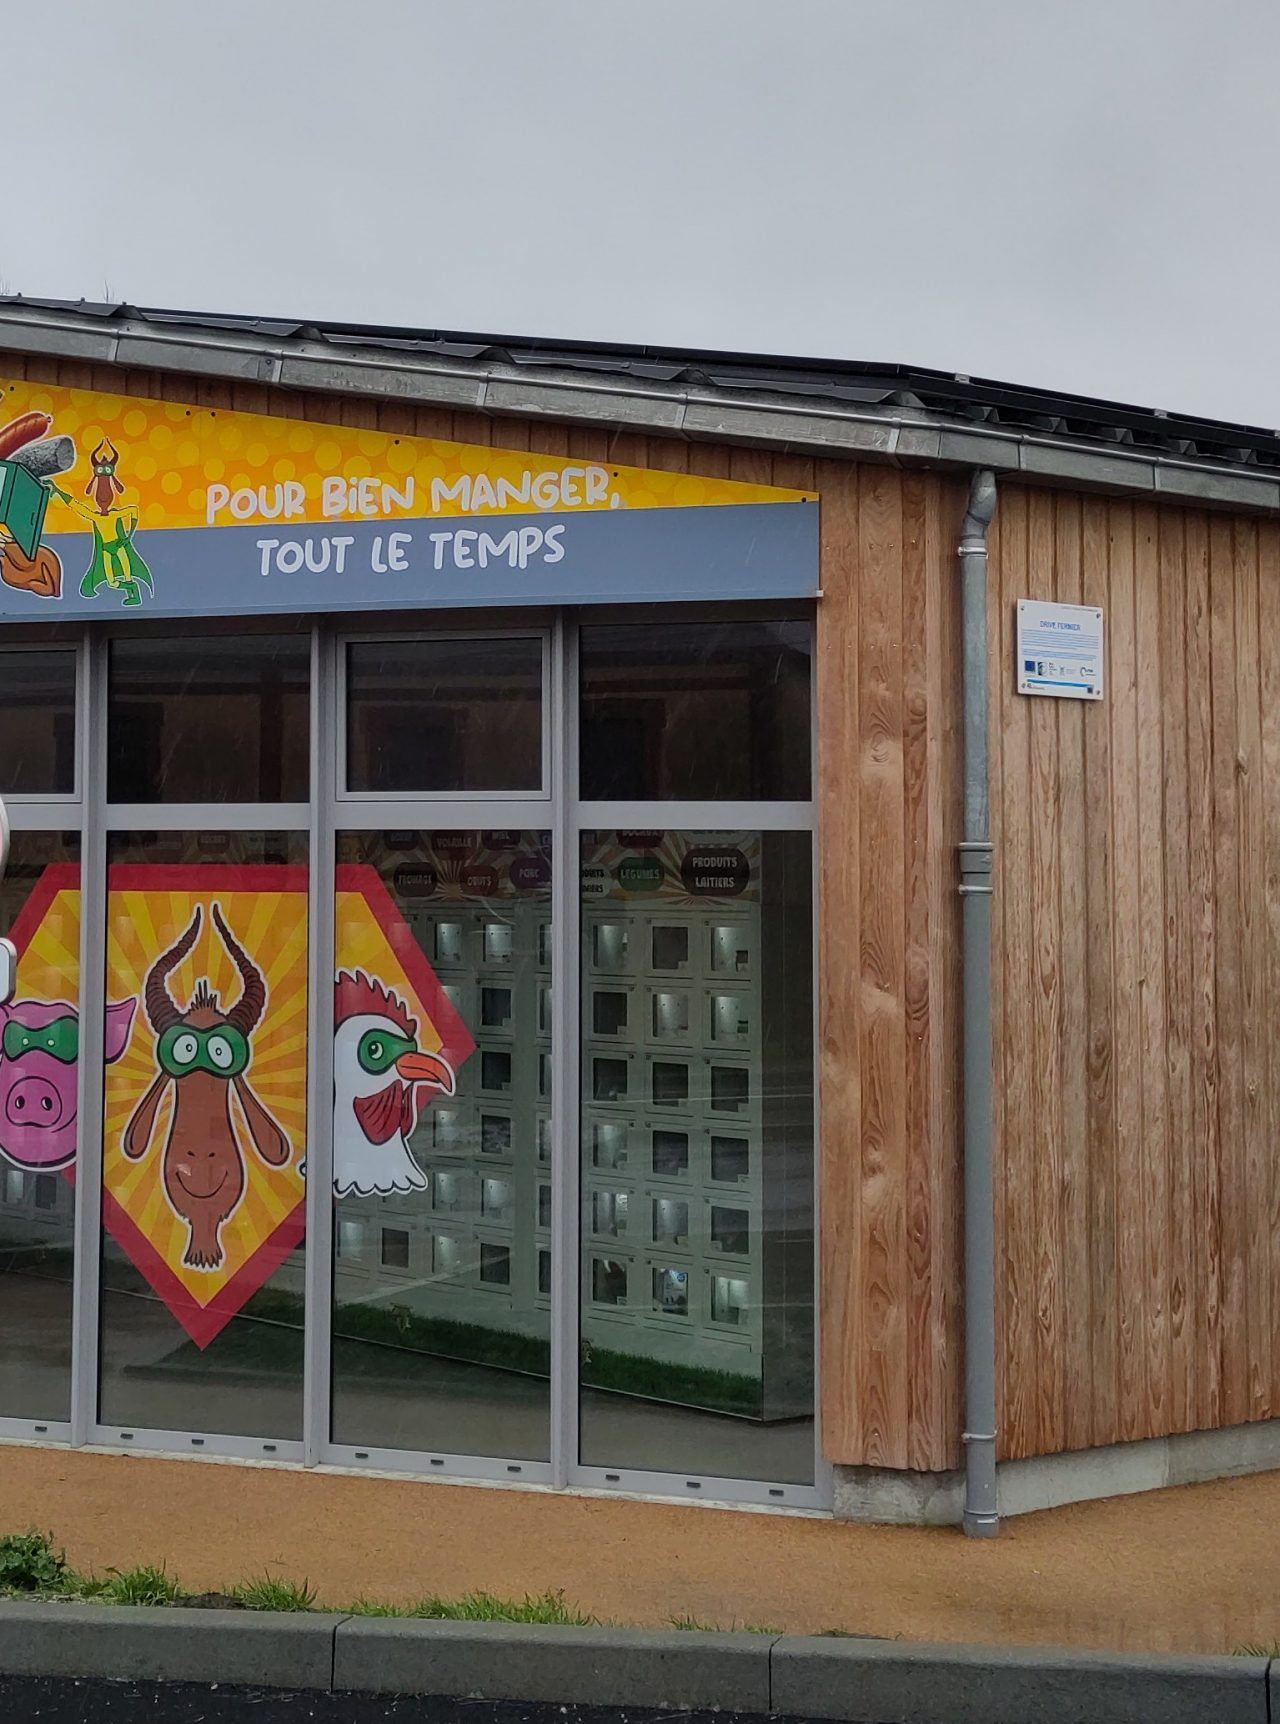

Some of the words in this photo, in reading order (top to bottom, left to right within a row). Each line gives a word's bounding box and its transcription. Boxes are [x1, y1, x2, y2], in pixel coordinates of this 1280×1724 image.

[206, 481, 305, 524] POUR
[430, 466, 620, 516] MANGER,
[256, 536, 355, 577] TOUT
[371, 532, 413, 574] LE
[429, 524, 566, 570] TEMPS
[692, 856, 738, 868] PRODUITS
